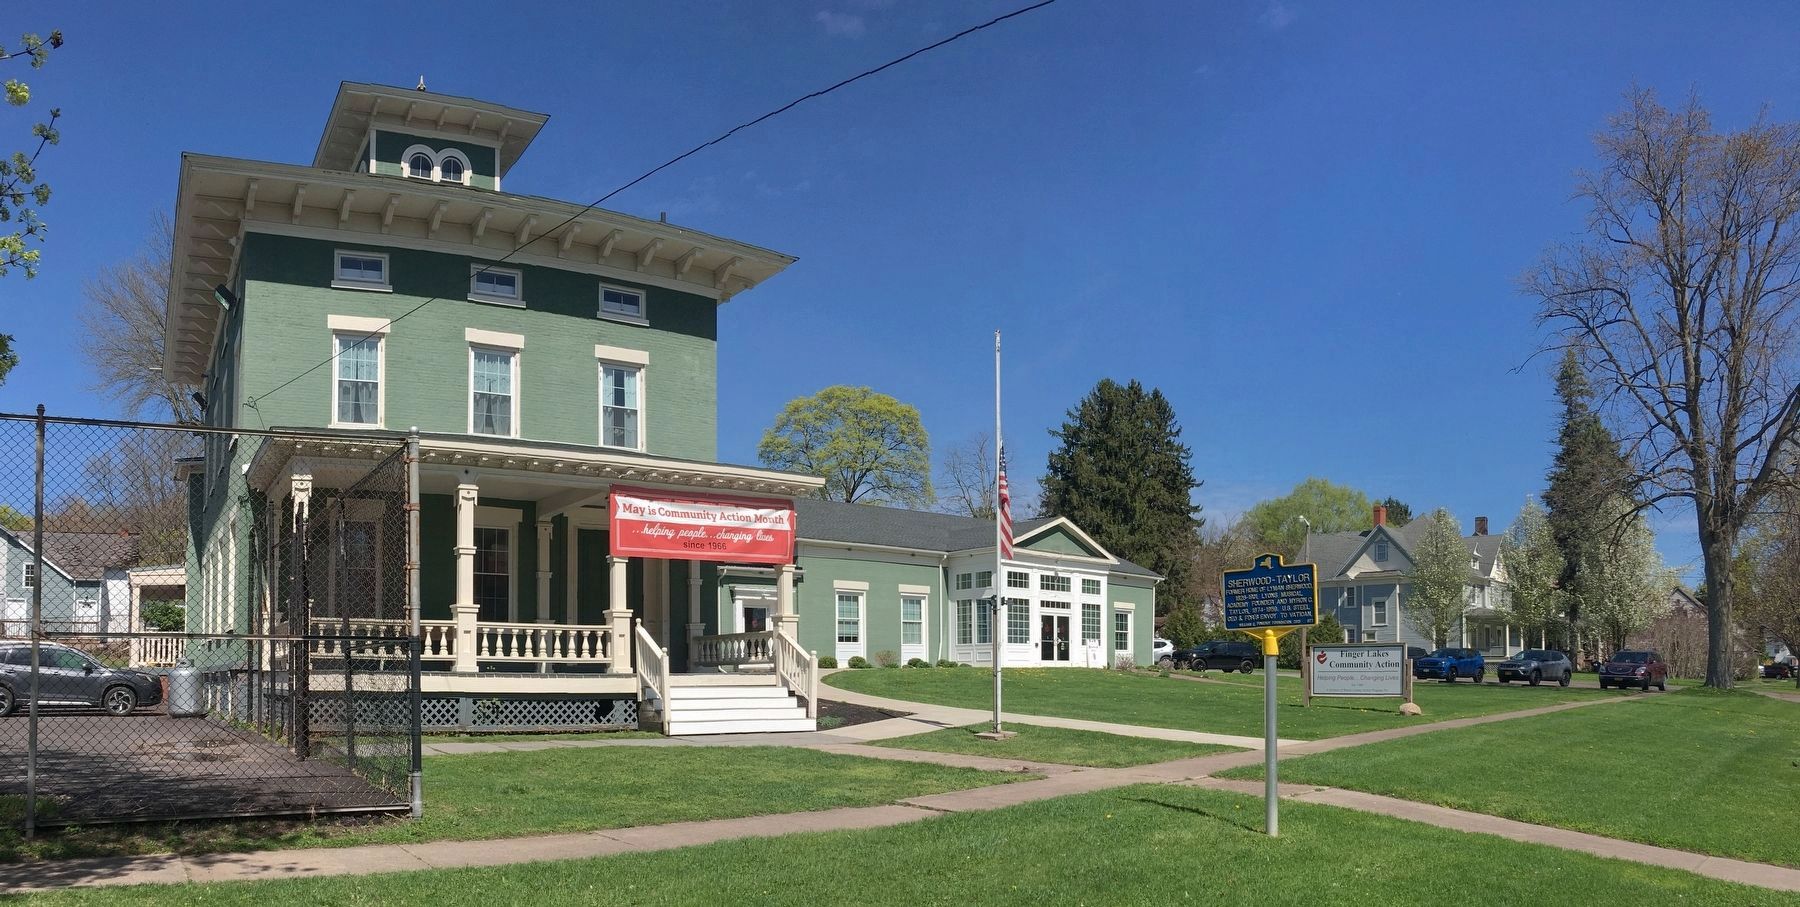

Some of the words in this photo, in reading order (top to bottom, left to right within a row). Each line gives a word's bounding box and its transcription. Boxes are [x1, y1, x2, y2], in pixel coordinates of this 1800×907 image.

[622, 503, 646, 516] May
[648, 505, 656, 516] is
[658, 507, 717, 522] Community
[720, 513, 751, 522] Action
[754, 514, 784, 524] Month
[756, 530, 774, 542] lives
[683, 541, 704, 550] since
[708, 542, 726, 550] 1966
[1228, 573, 1310, 588] SHERWOOD-TAYLOR
[1340, 650, 1364, 658] Finger
[1368, 650, 1390, 658] Lakes
[1329, 660, 1373, 670] Community
[1317, 674, 1336, 682] Helping
